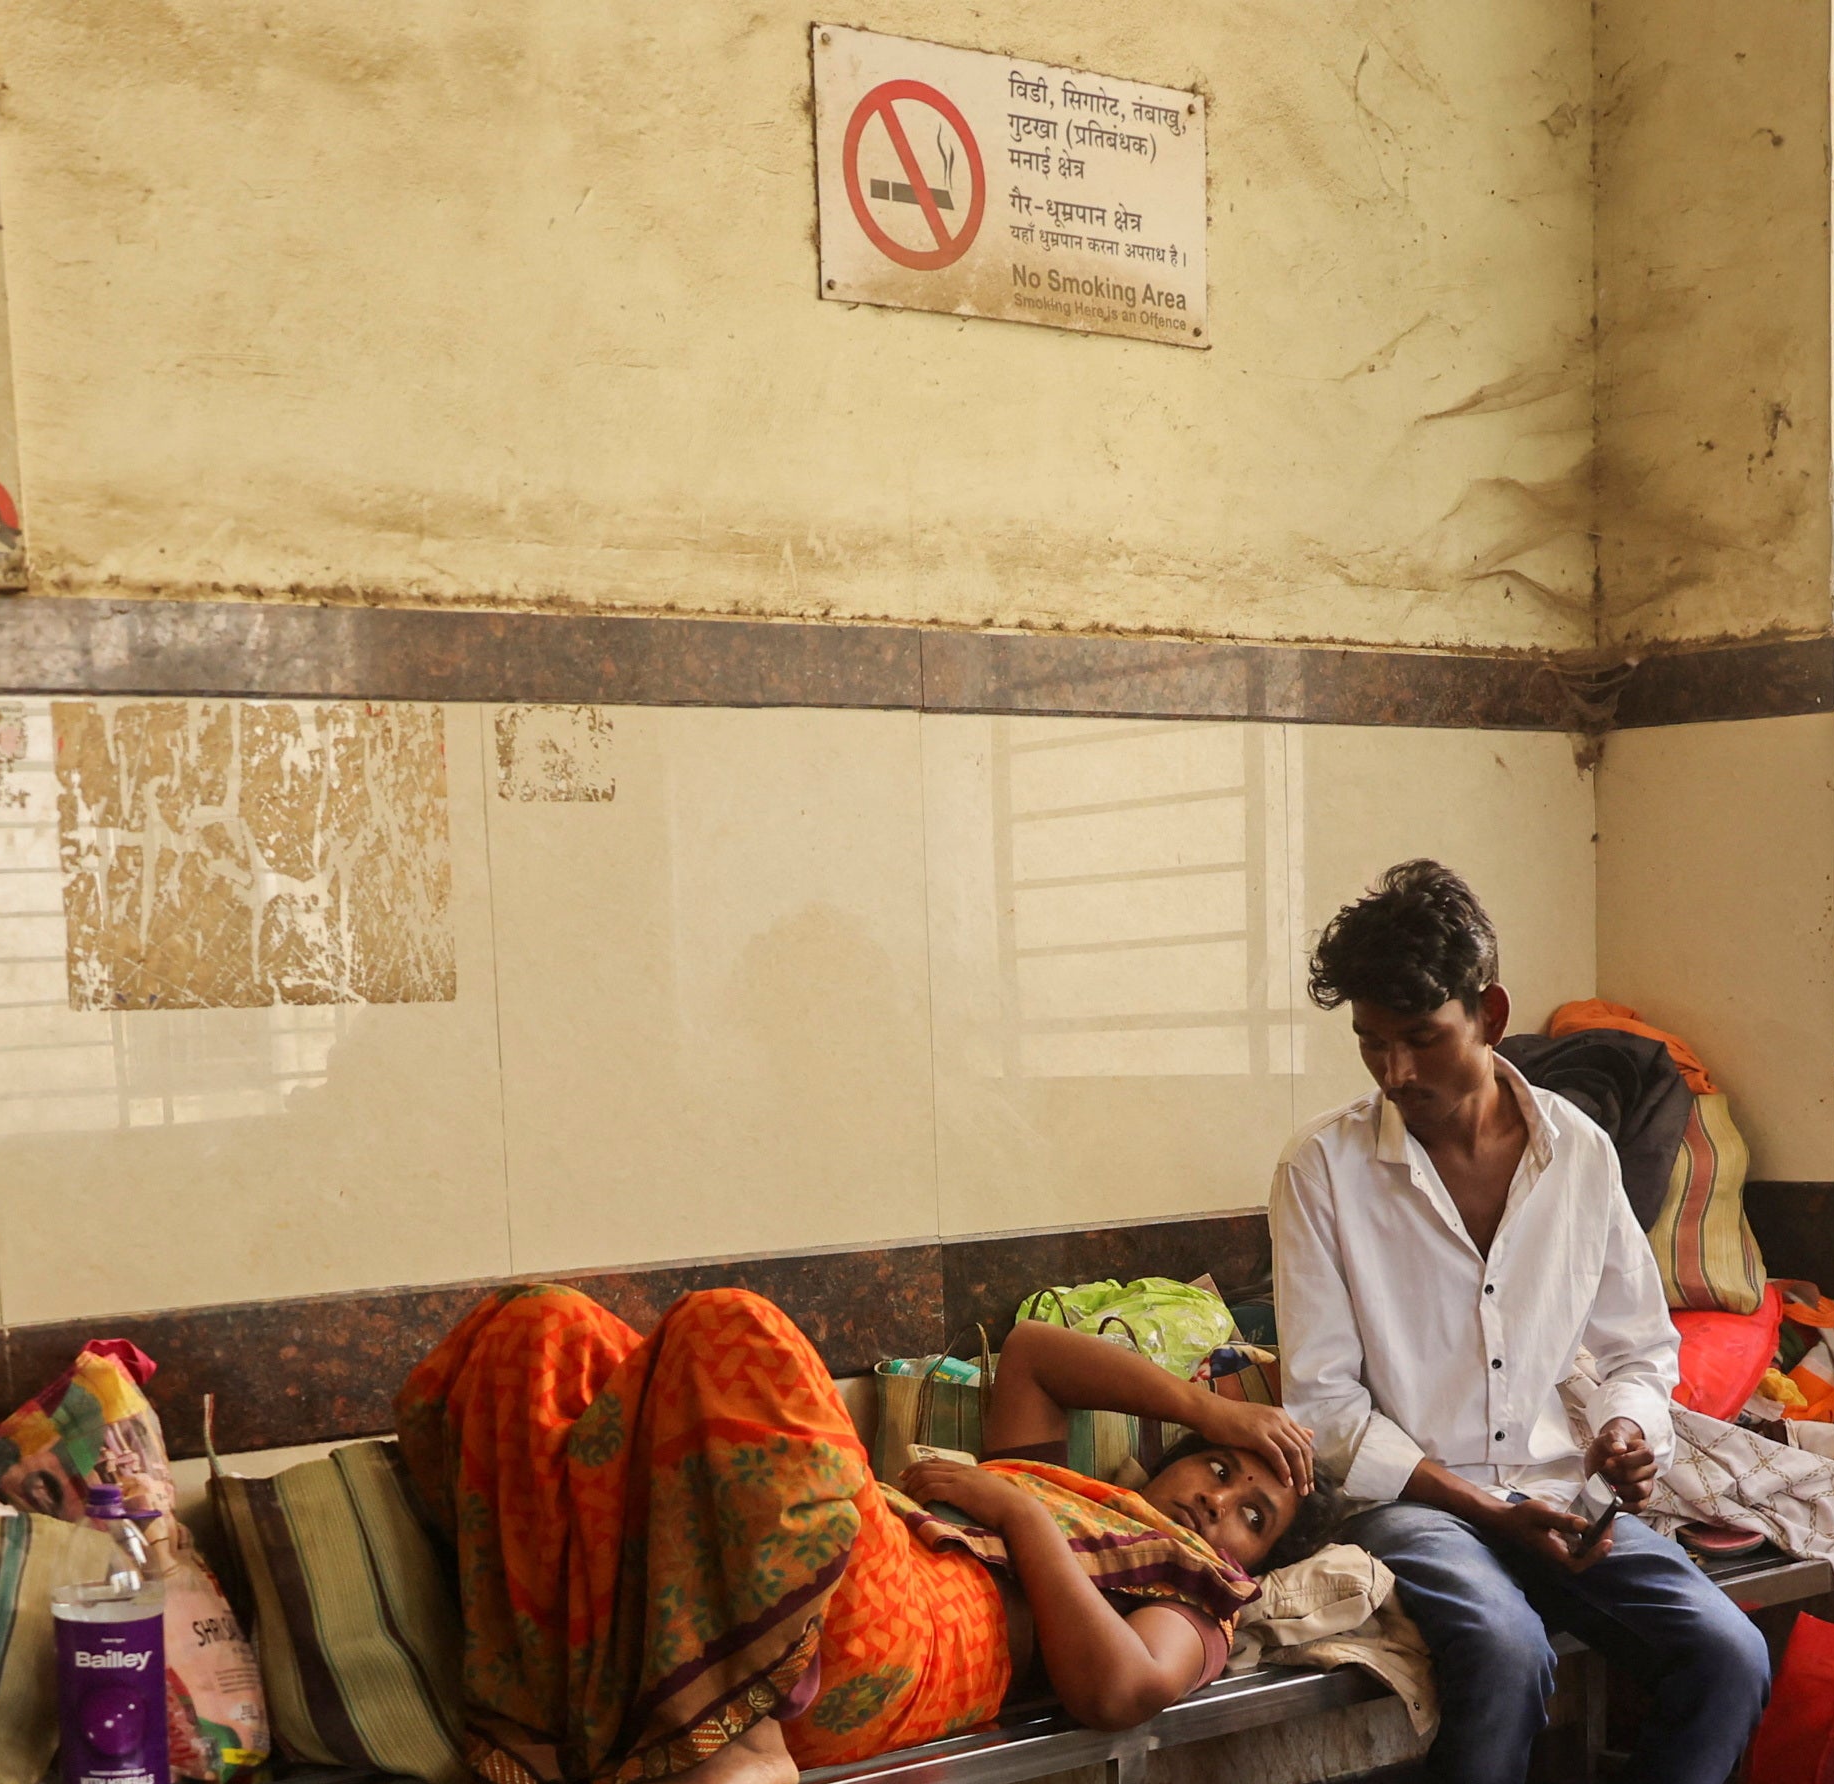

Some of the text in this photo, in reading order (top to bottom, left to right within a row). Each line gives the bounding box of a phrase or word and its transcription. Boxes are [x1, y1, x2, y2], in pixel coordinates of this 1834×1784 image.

[1007, 70, 1054, 111] विडी,
[1061, 80, 1127, 123] सिगारेट,
[1007, 113, 1157, 164] गुटखा (प्रतिबंधक)
[1007, 146, 1086, 180] मनाई क्षेत्र
[1008, 185, 1143, 233] गैर-धूम्रपान क्षेत्र
[1009, 224, 1035, 245] यहाँ
[1087, 236, 1119, 256] करना
[1124, 243, 1166, 263] अपराध
[1012, 263, 1187, 311] No Smoking Area
[1013, 293, 1187, 331] Smoking Here is an Offence
[74, 1650, 153, 1671] Bailley
